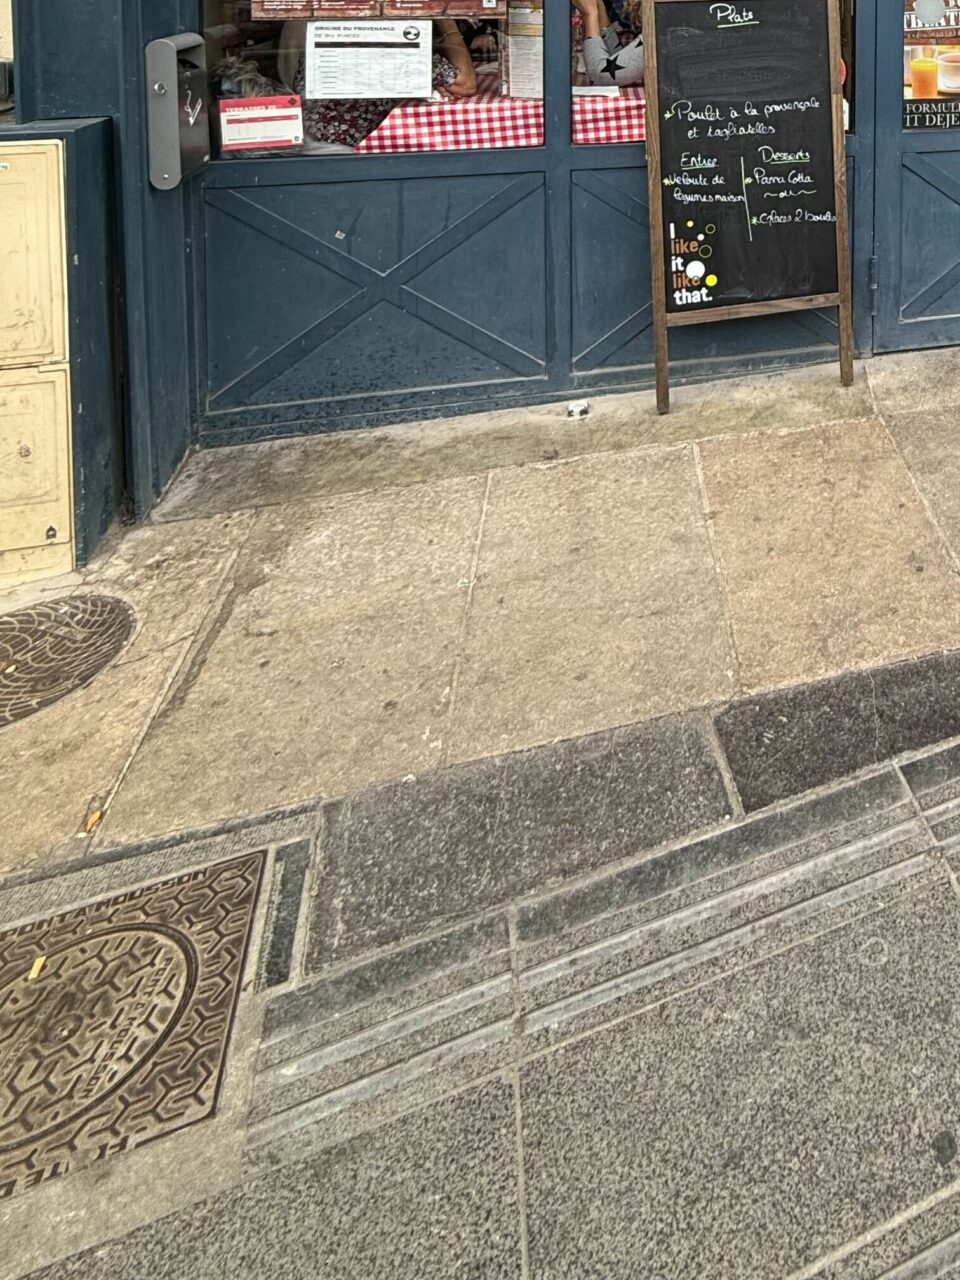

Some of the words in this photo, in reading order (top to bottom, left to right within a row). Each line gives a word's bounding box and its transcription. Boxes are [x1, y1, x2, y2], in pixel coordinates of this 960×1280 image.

[709, 3, 753, 22] Plats
[672, 100, 725, 121] Poulet
[730, 106, 741, 119] à
[745, 101, 760, 116] la
[764, 97, 820, 118] provençale
[688, 126, 700, 138] et
[707, 122, 776, 140] tagliatelles
[758, 146, 810, 162] Desserts
[712, 174, 725, 184] de
[753, 167, 786, 184] Panna
[788, 170, 814, 184] Cotta
[715, 192, 745, 202] maison
[759, 210, 792, 226] Glaces
[795, 209, 803, 222] 2
[805, 210, 836, 221] boules
[670, 223, 676, 239] I
[670, 239, 699, 254] like
[671, 256, 685, 272] it
[672, 273, 701, 289] like
[674, 287, 713, 306] that.
[94, 869, 208, 912] MOUSSON
[80, 1016, 137, 1099] MOUSSON
